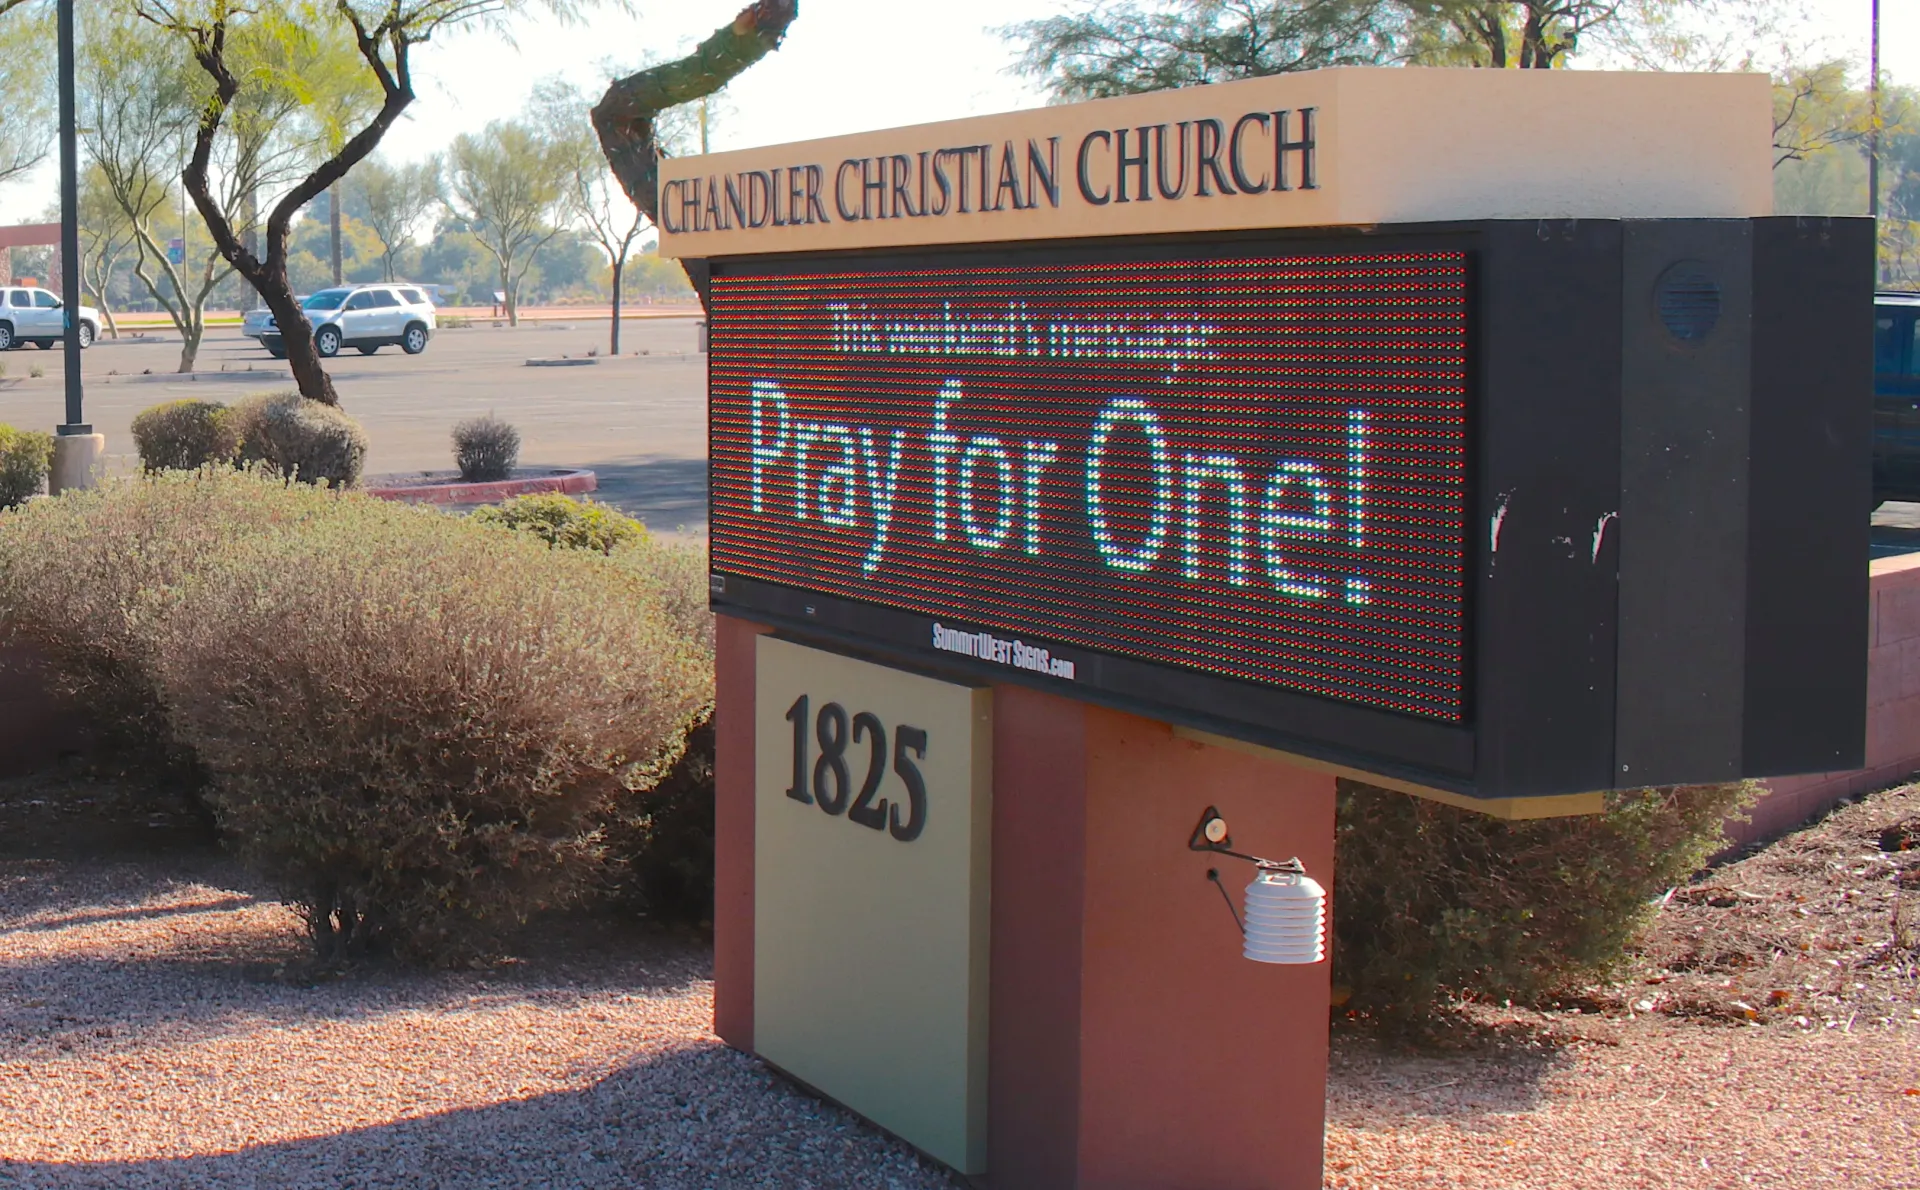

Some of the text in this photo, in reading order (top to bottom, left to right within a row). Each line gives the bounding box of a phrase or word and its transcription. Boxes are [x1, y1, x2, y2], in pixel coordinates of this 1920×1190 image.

[662, 107, 1319, 234] CHANDLER CHRISTIAN CHURCH
[752, 379, 1371, 606] Pray for One!
[786, 694, 927, 842] 1825
